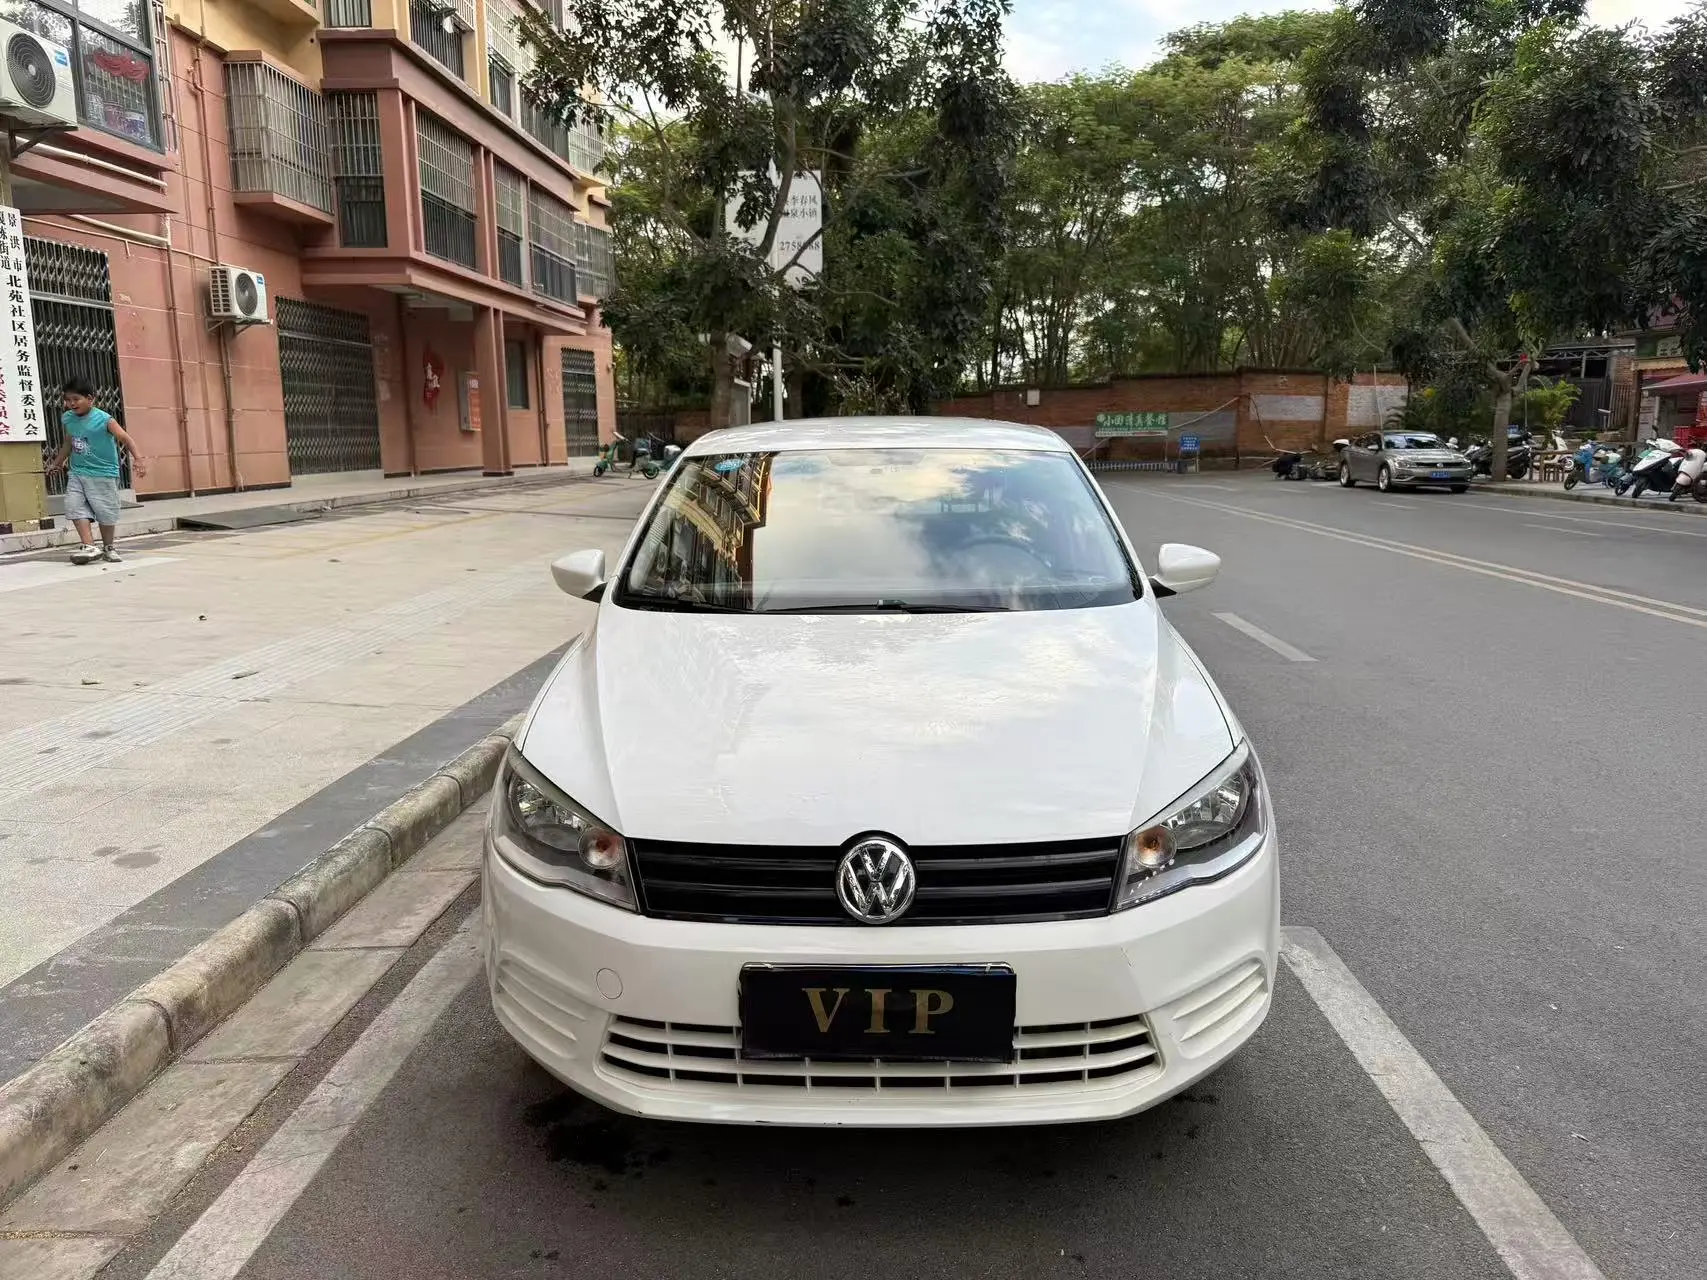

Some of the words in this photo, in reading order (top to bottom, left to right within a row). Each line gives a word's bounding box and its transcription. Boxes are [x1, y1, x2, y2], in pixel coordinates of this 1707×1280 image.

[8, 212, 22, 272] 景洪市
[779, 241, 820, 251] 275888
[6, 274, 40, 436] 北苑社区居务监督委员会
[801, 987, 954, 1034] VIP
